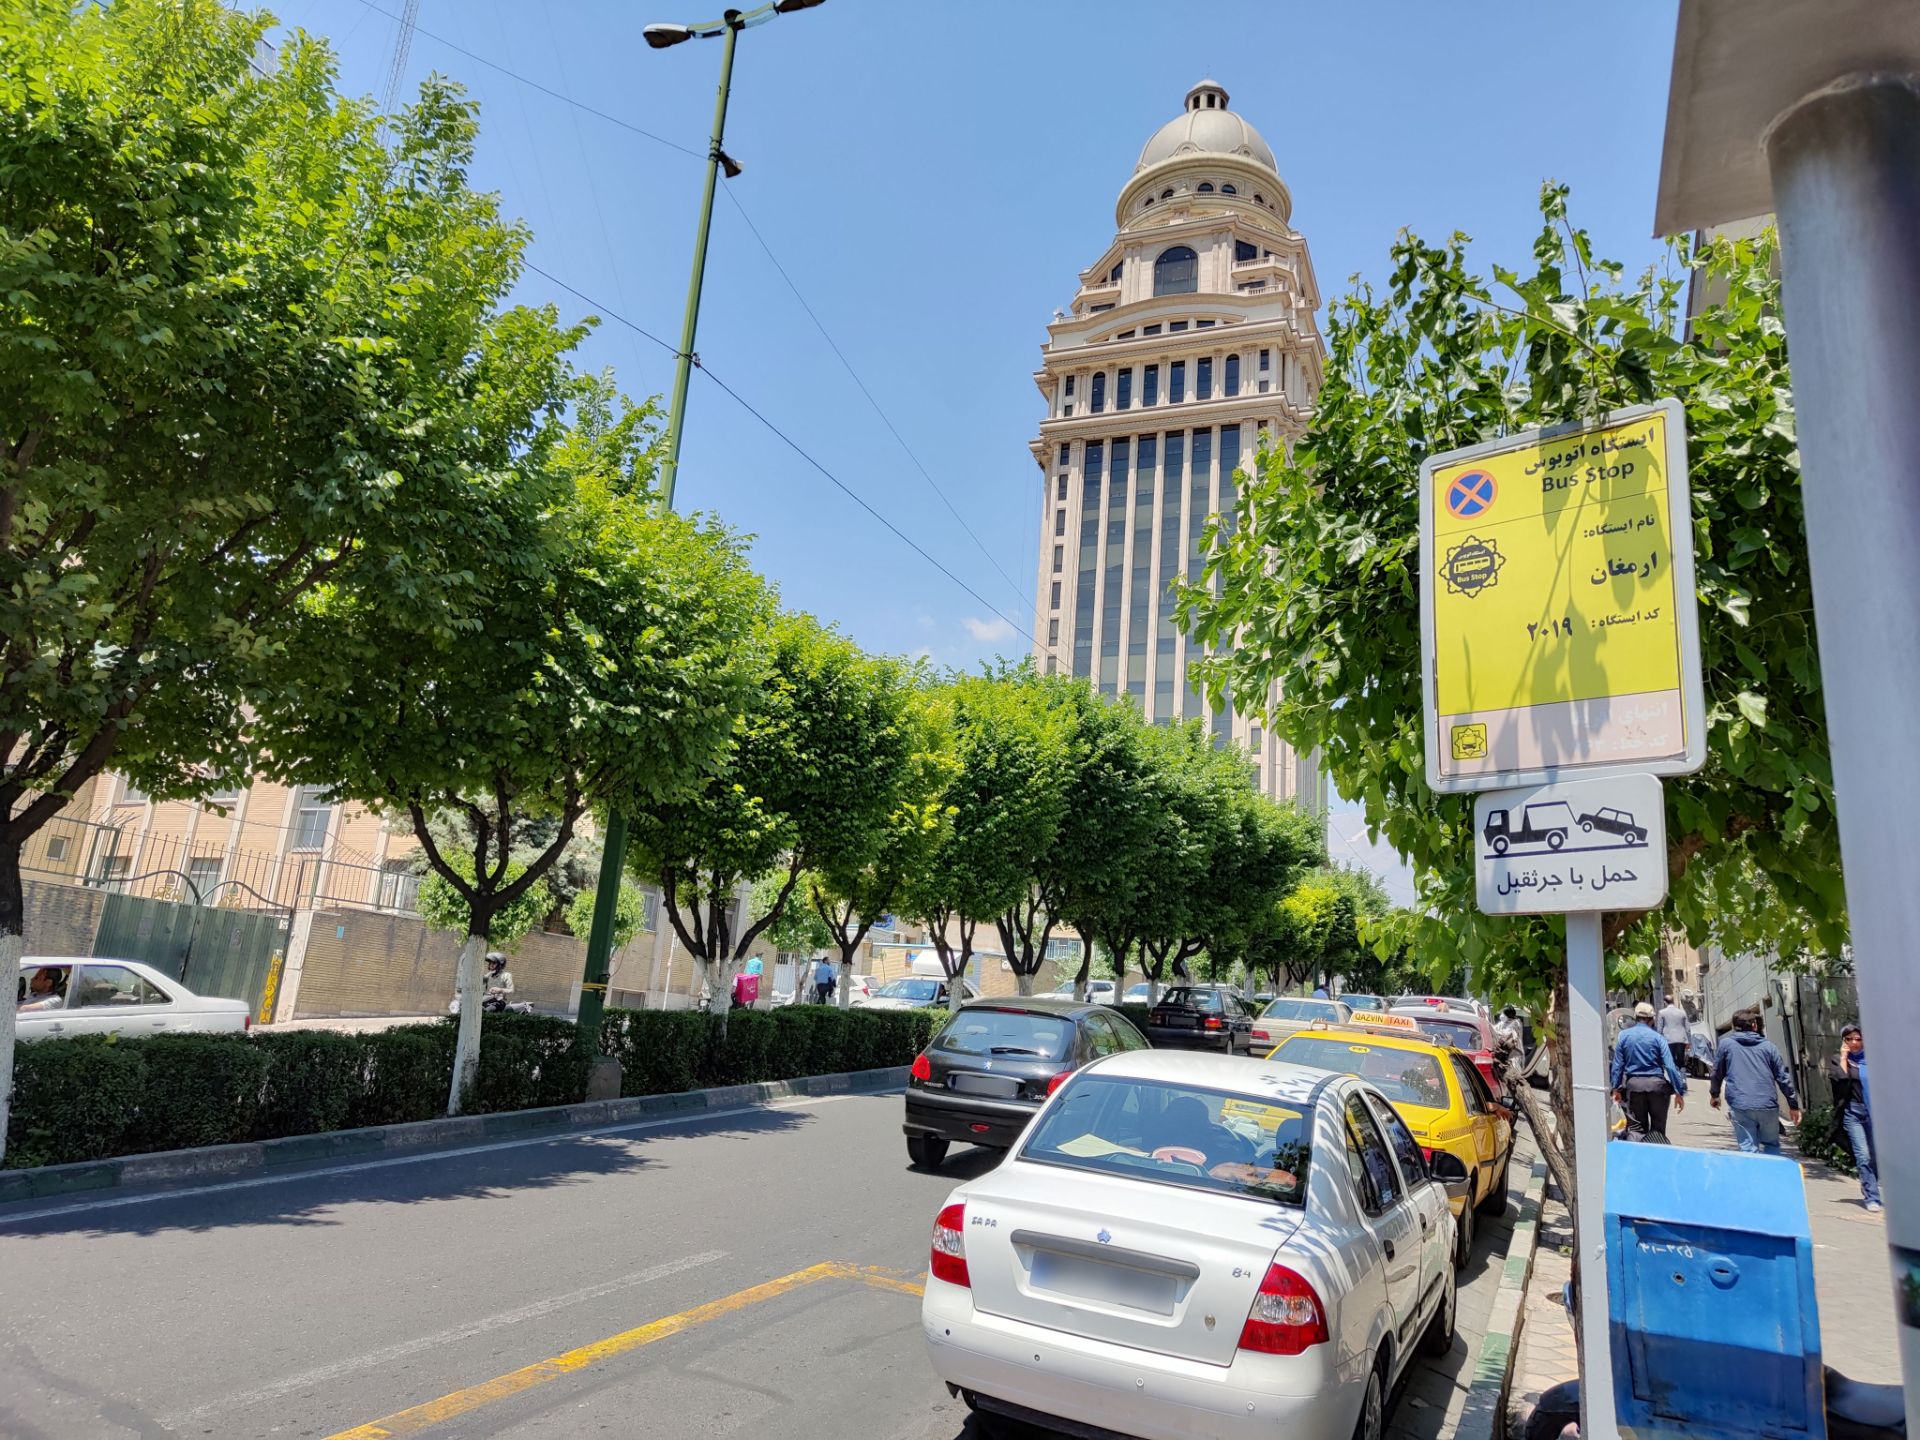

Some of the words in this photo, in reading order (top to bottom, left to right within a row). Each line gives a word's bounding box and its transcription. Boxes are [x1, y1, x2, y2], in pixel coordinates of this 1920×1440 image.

[1590, 427, 1654, 456] ایستگاه
[1524, 444, 1585, 476] اتوبوس
[1542, 474, 1579, 492] Bus
[1585, 462, 1634, 483] Stop
[1637, 514, 1655, 531] نام
[1591, 551, 1657, 585] ارمغان
[1644, 608, 1660, 620] کد
[1527, 617, 1573, 642] ۲۰۱۹
[1497, 870, 1563, 896] جرثقیل
[1570, 867, 1584, 890] با
[1591, 865, 1638, 891] حمل
[1354, 1012, 1384, 1024] QAZVIN
[1388, 1016, 1410, 1026] TAXI
